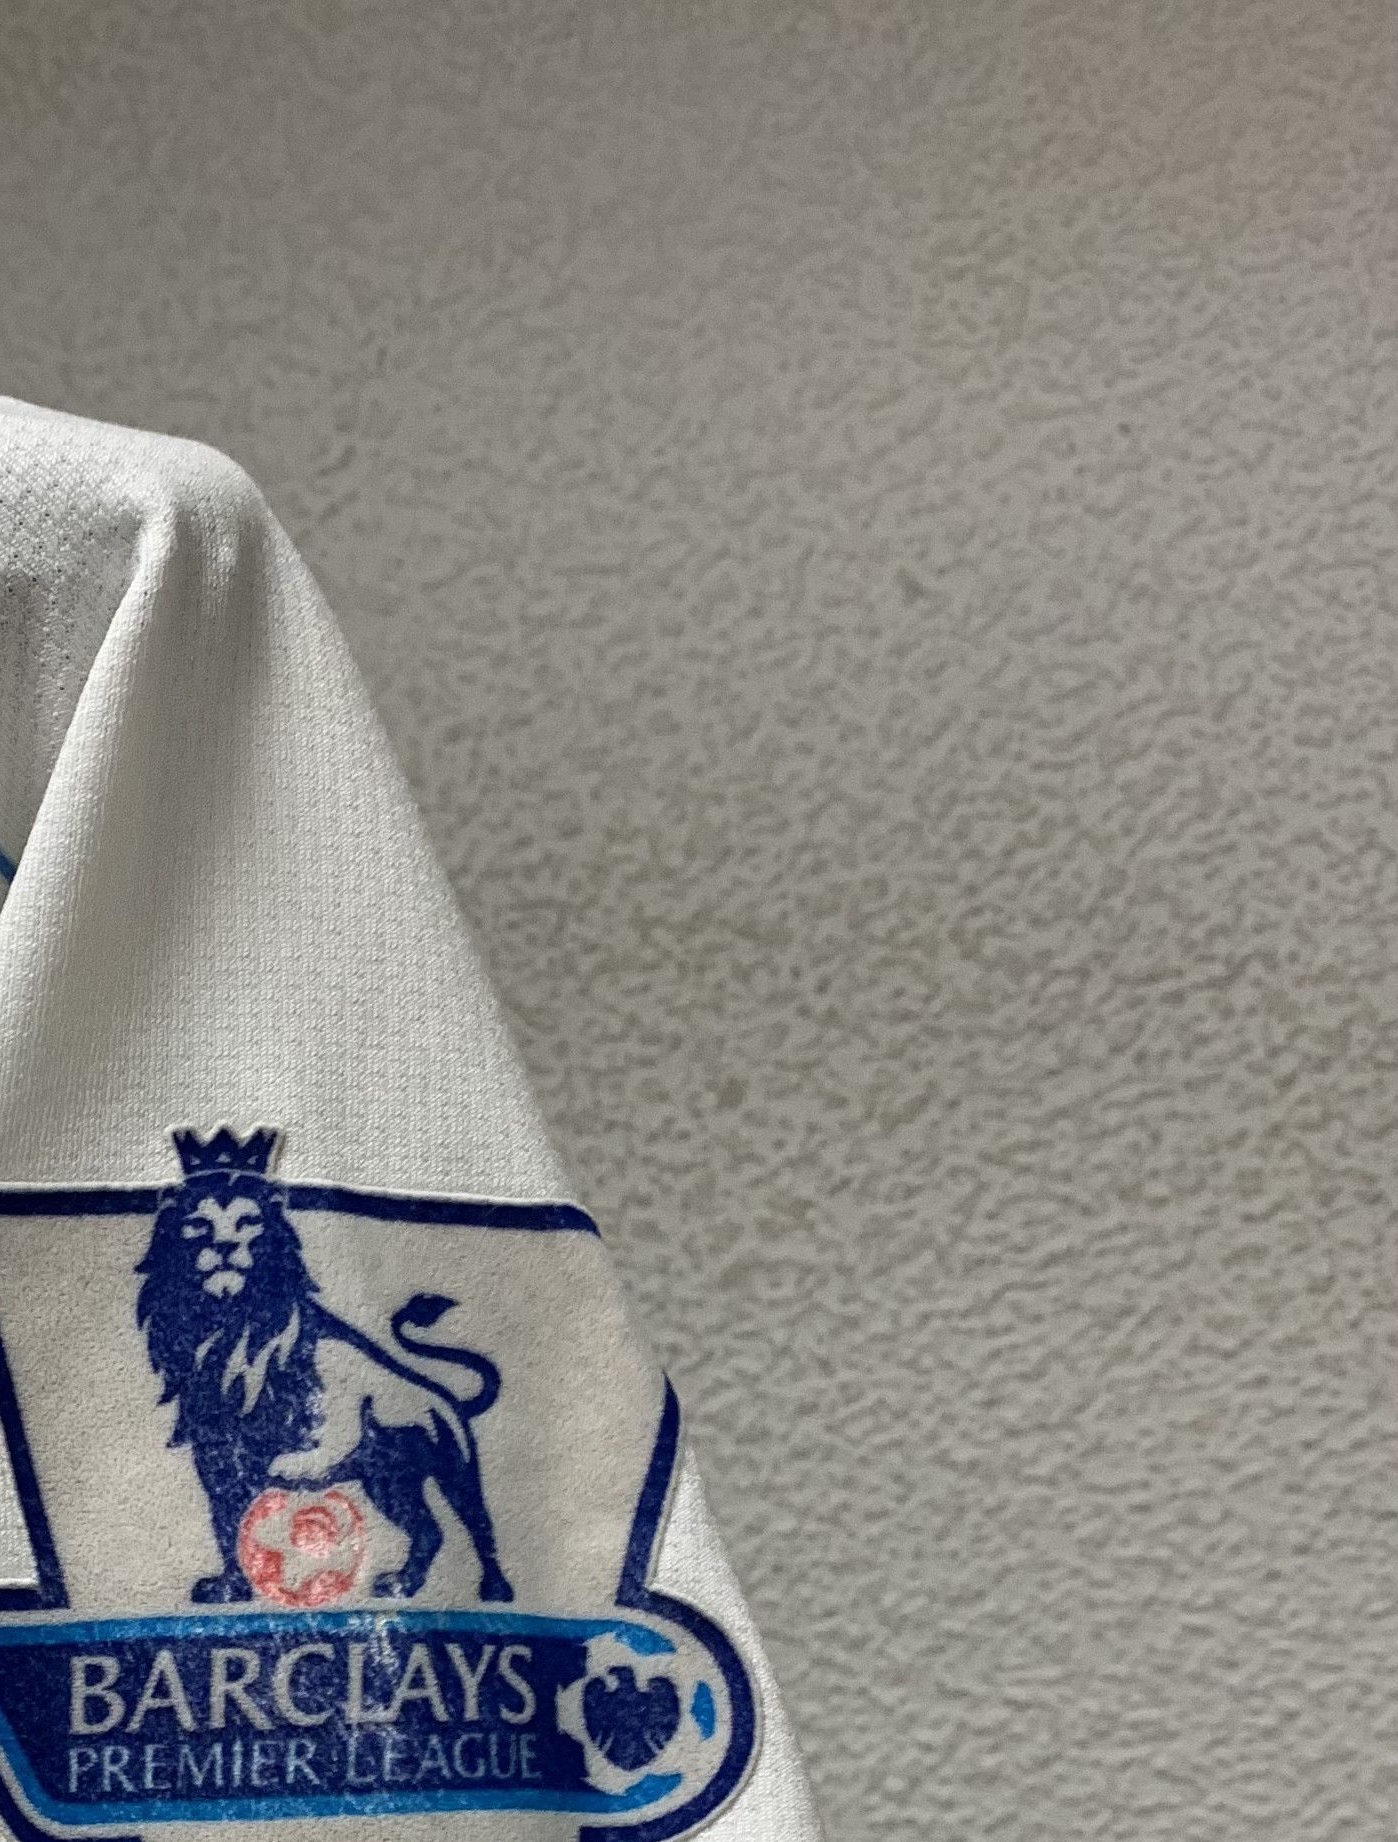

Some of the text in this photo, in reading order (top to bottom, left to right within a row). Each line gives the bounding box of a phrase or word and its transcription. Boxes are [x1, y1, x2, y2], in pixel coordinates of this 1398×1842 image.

[67, 1643, 538, 1735] BARCLAYS
[68, 1733, 542, 1793] PREMIER LEAGUE
